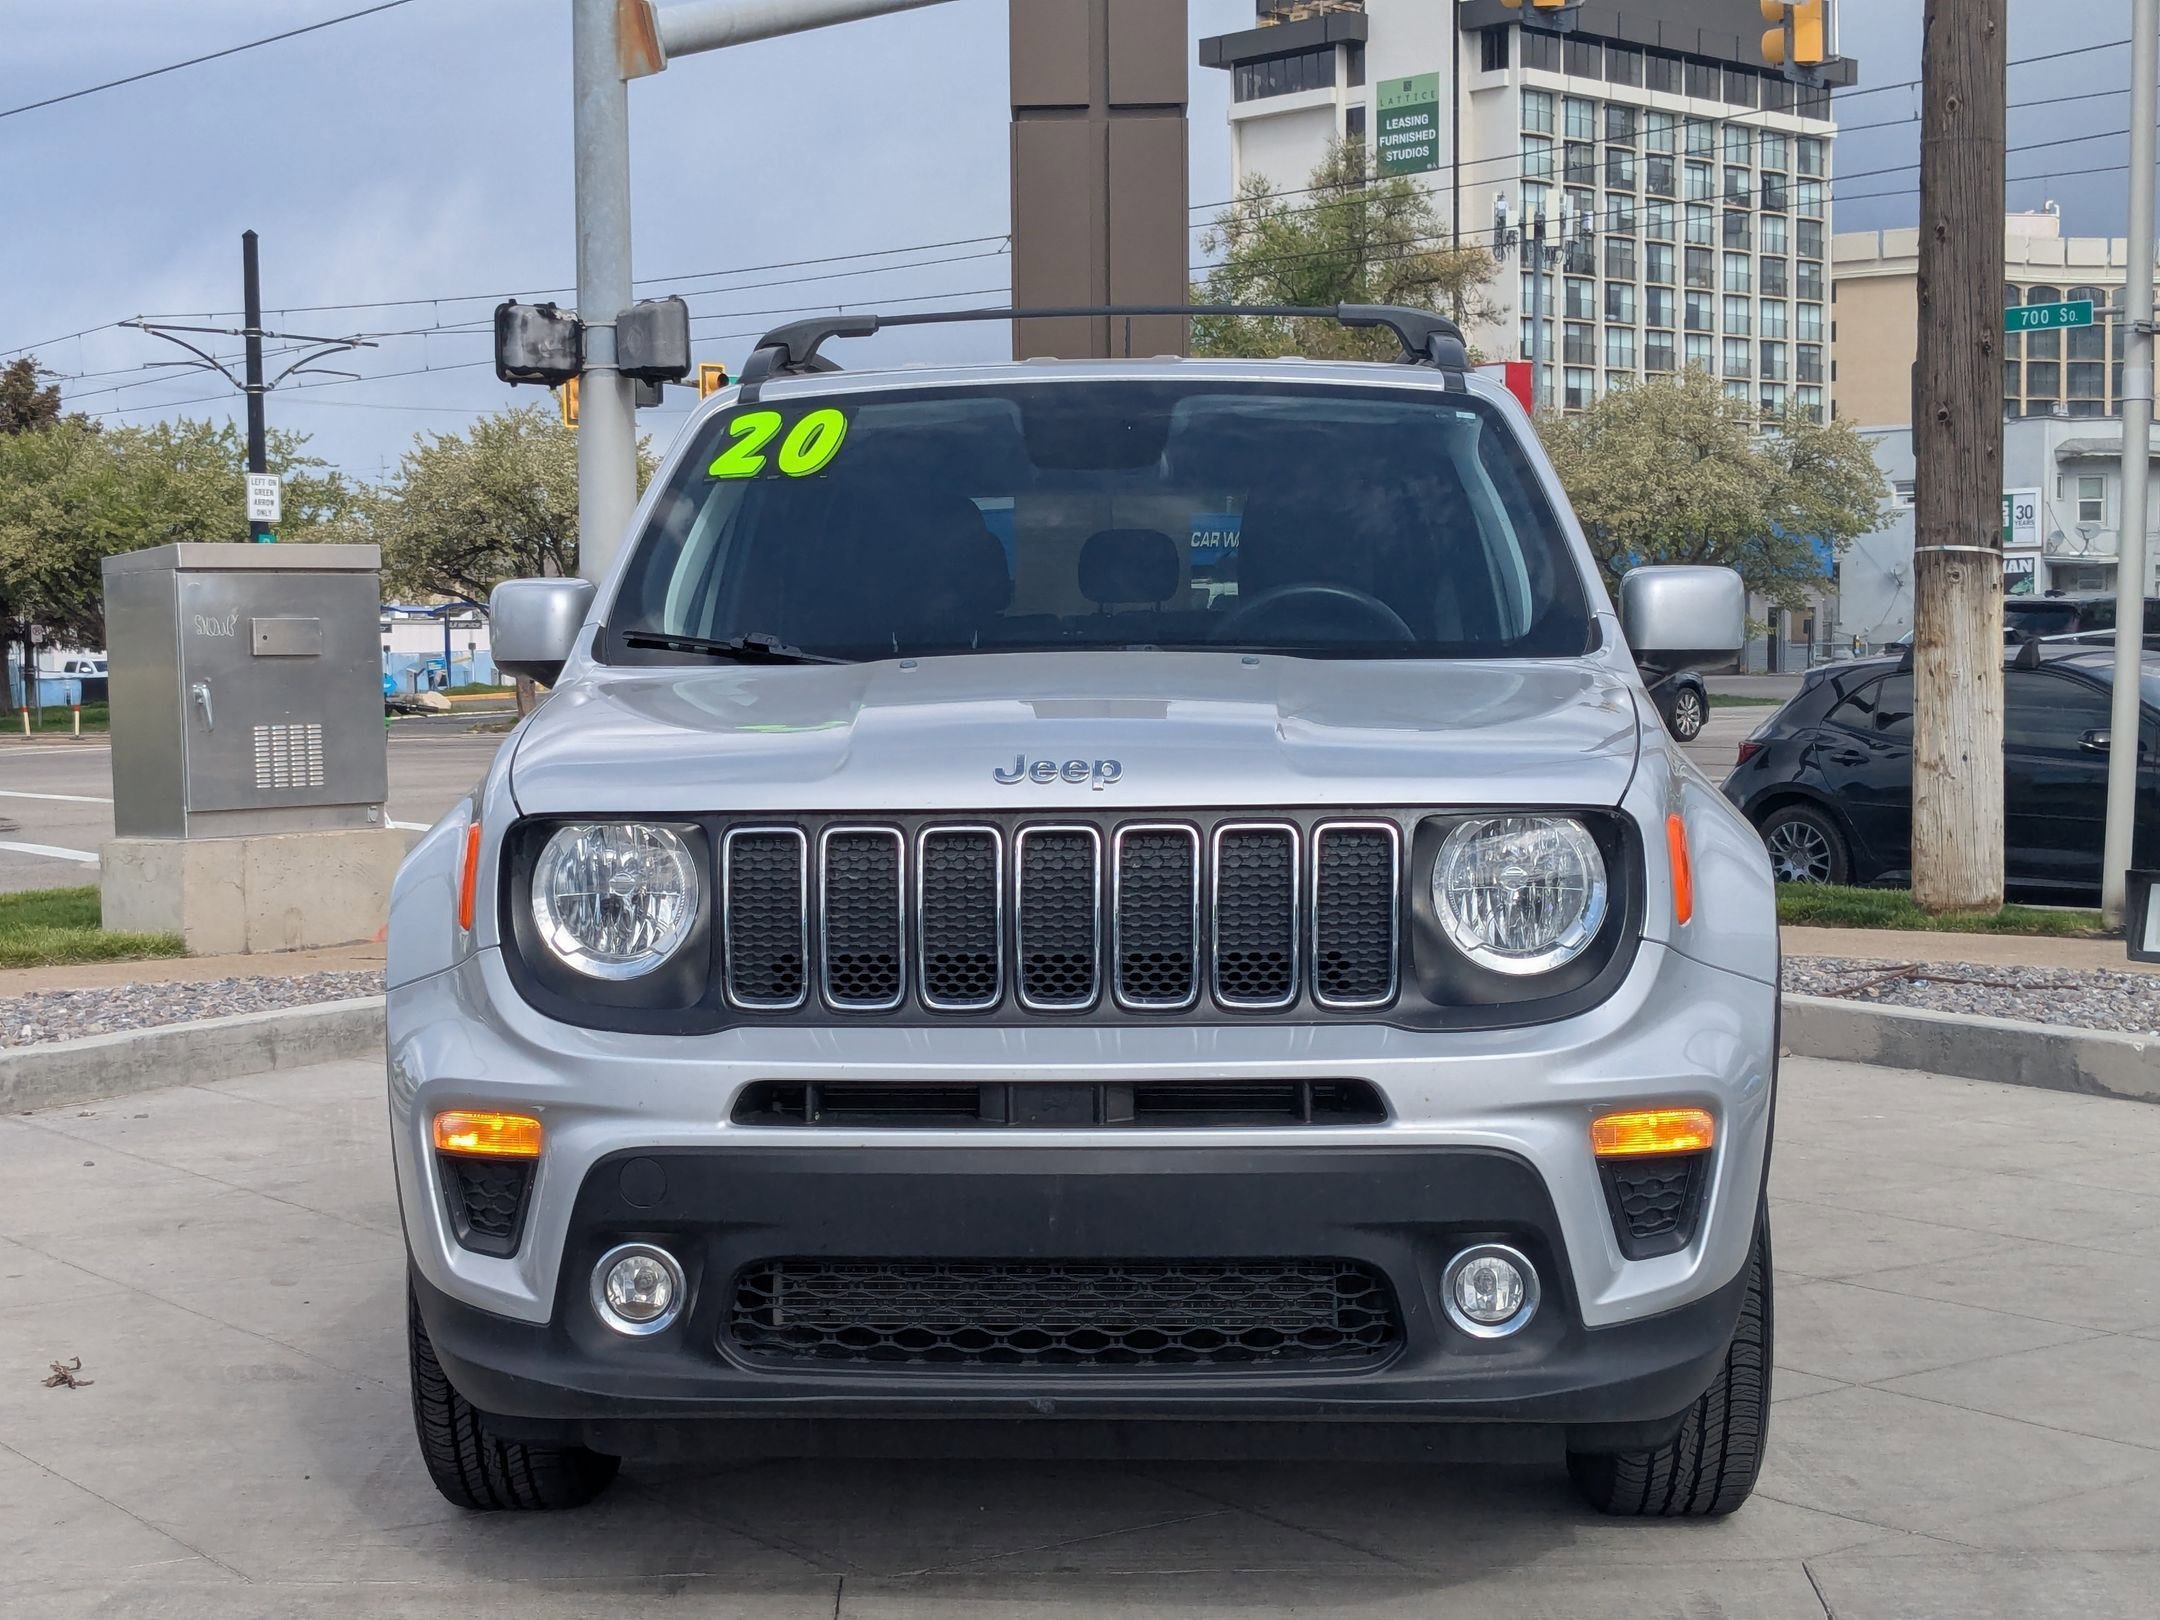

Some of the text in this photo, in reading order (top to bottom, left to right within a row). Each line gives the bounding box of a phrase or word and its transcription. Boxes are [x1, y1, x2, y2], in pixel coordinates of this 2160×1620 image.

[1380, 90, 1436, 107] LATTICE
[1386, 114, 1429, 130] LEASING
[1379, 129, 1436, 147] FURNISHED
[1386, 146, 1430, 162] STUDIOS
[2021, 309, 2049, 326] 700
[708, 408, 848, 479] 20
[251, 477, 265, 486] LEFT
[254, 488, 274, 497] GREEN
[254, 498, 274, 507] ARROW
[256, 508, 272, 517] ONLY
[2016, 504, 2033, 520] 30
[1190, 531, 1220, 548] CAR
[993, 754, 1124, 791] Jeep
